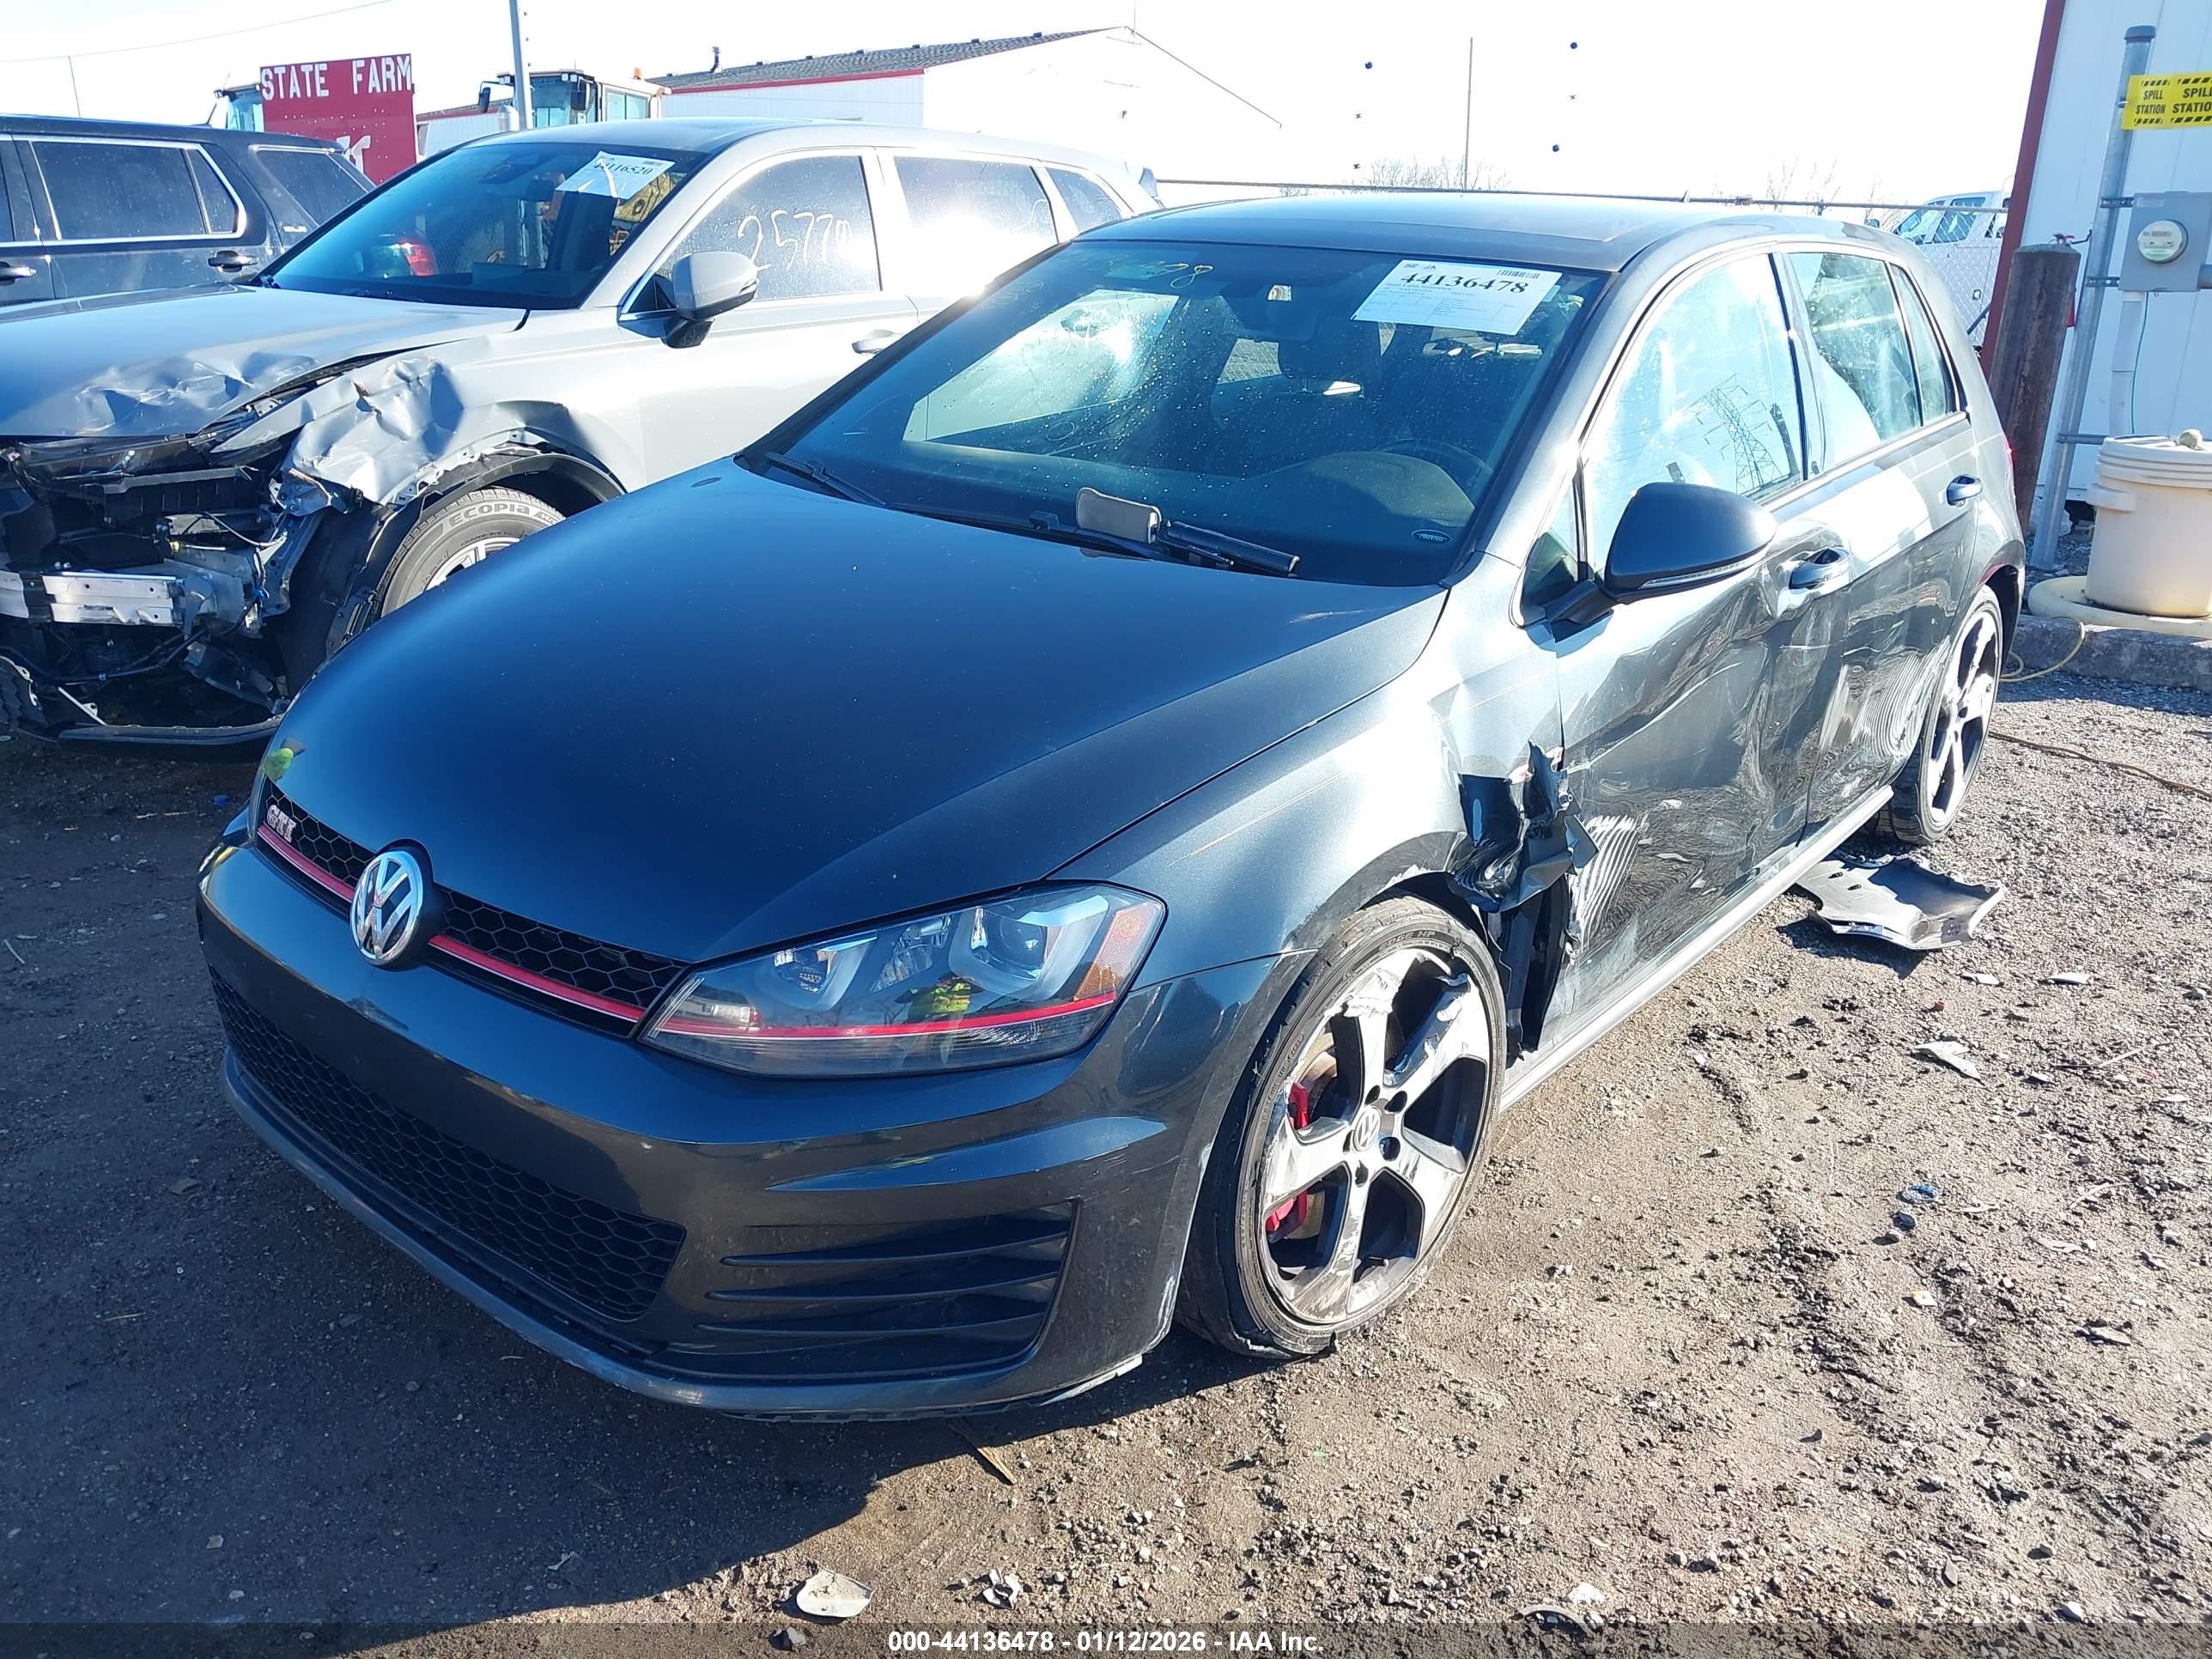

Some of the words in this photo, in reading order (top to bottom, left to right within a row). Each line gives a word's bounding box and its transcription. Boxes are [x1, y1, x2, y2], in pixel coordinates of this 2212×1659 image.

[261, 64, 329, 100] STATE
[353, 55, 412, 94] FARM
[2143, 89, 2163, 100] SPILL
[2136, 104, 2166, 115] STATION
[2172, 101, 2212, 113] STATIO
[1401, 271, 1528, 294] 44136478
[266, 805, 297, 843] GTI
